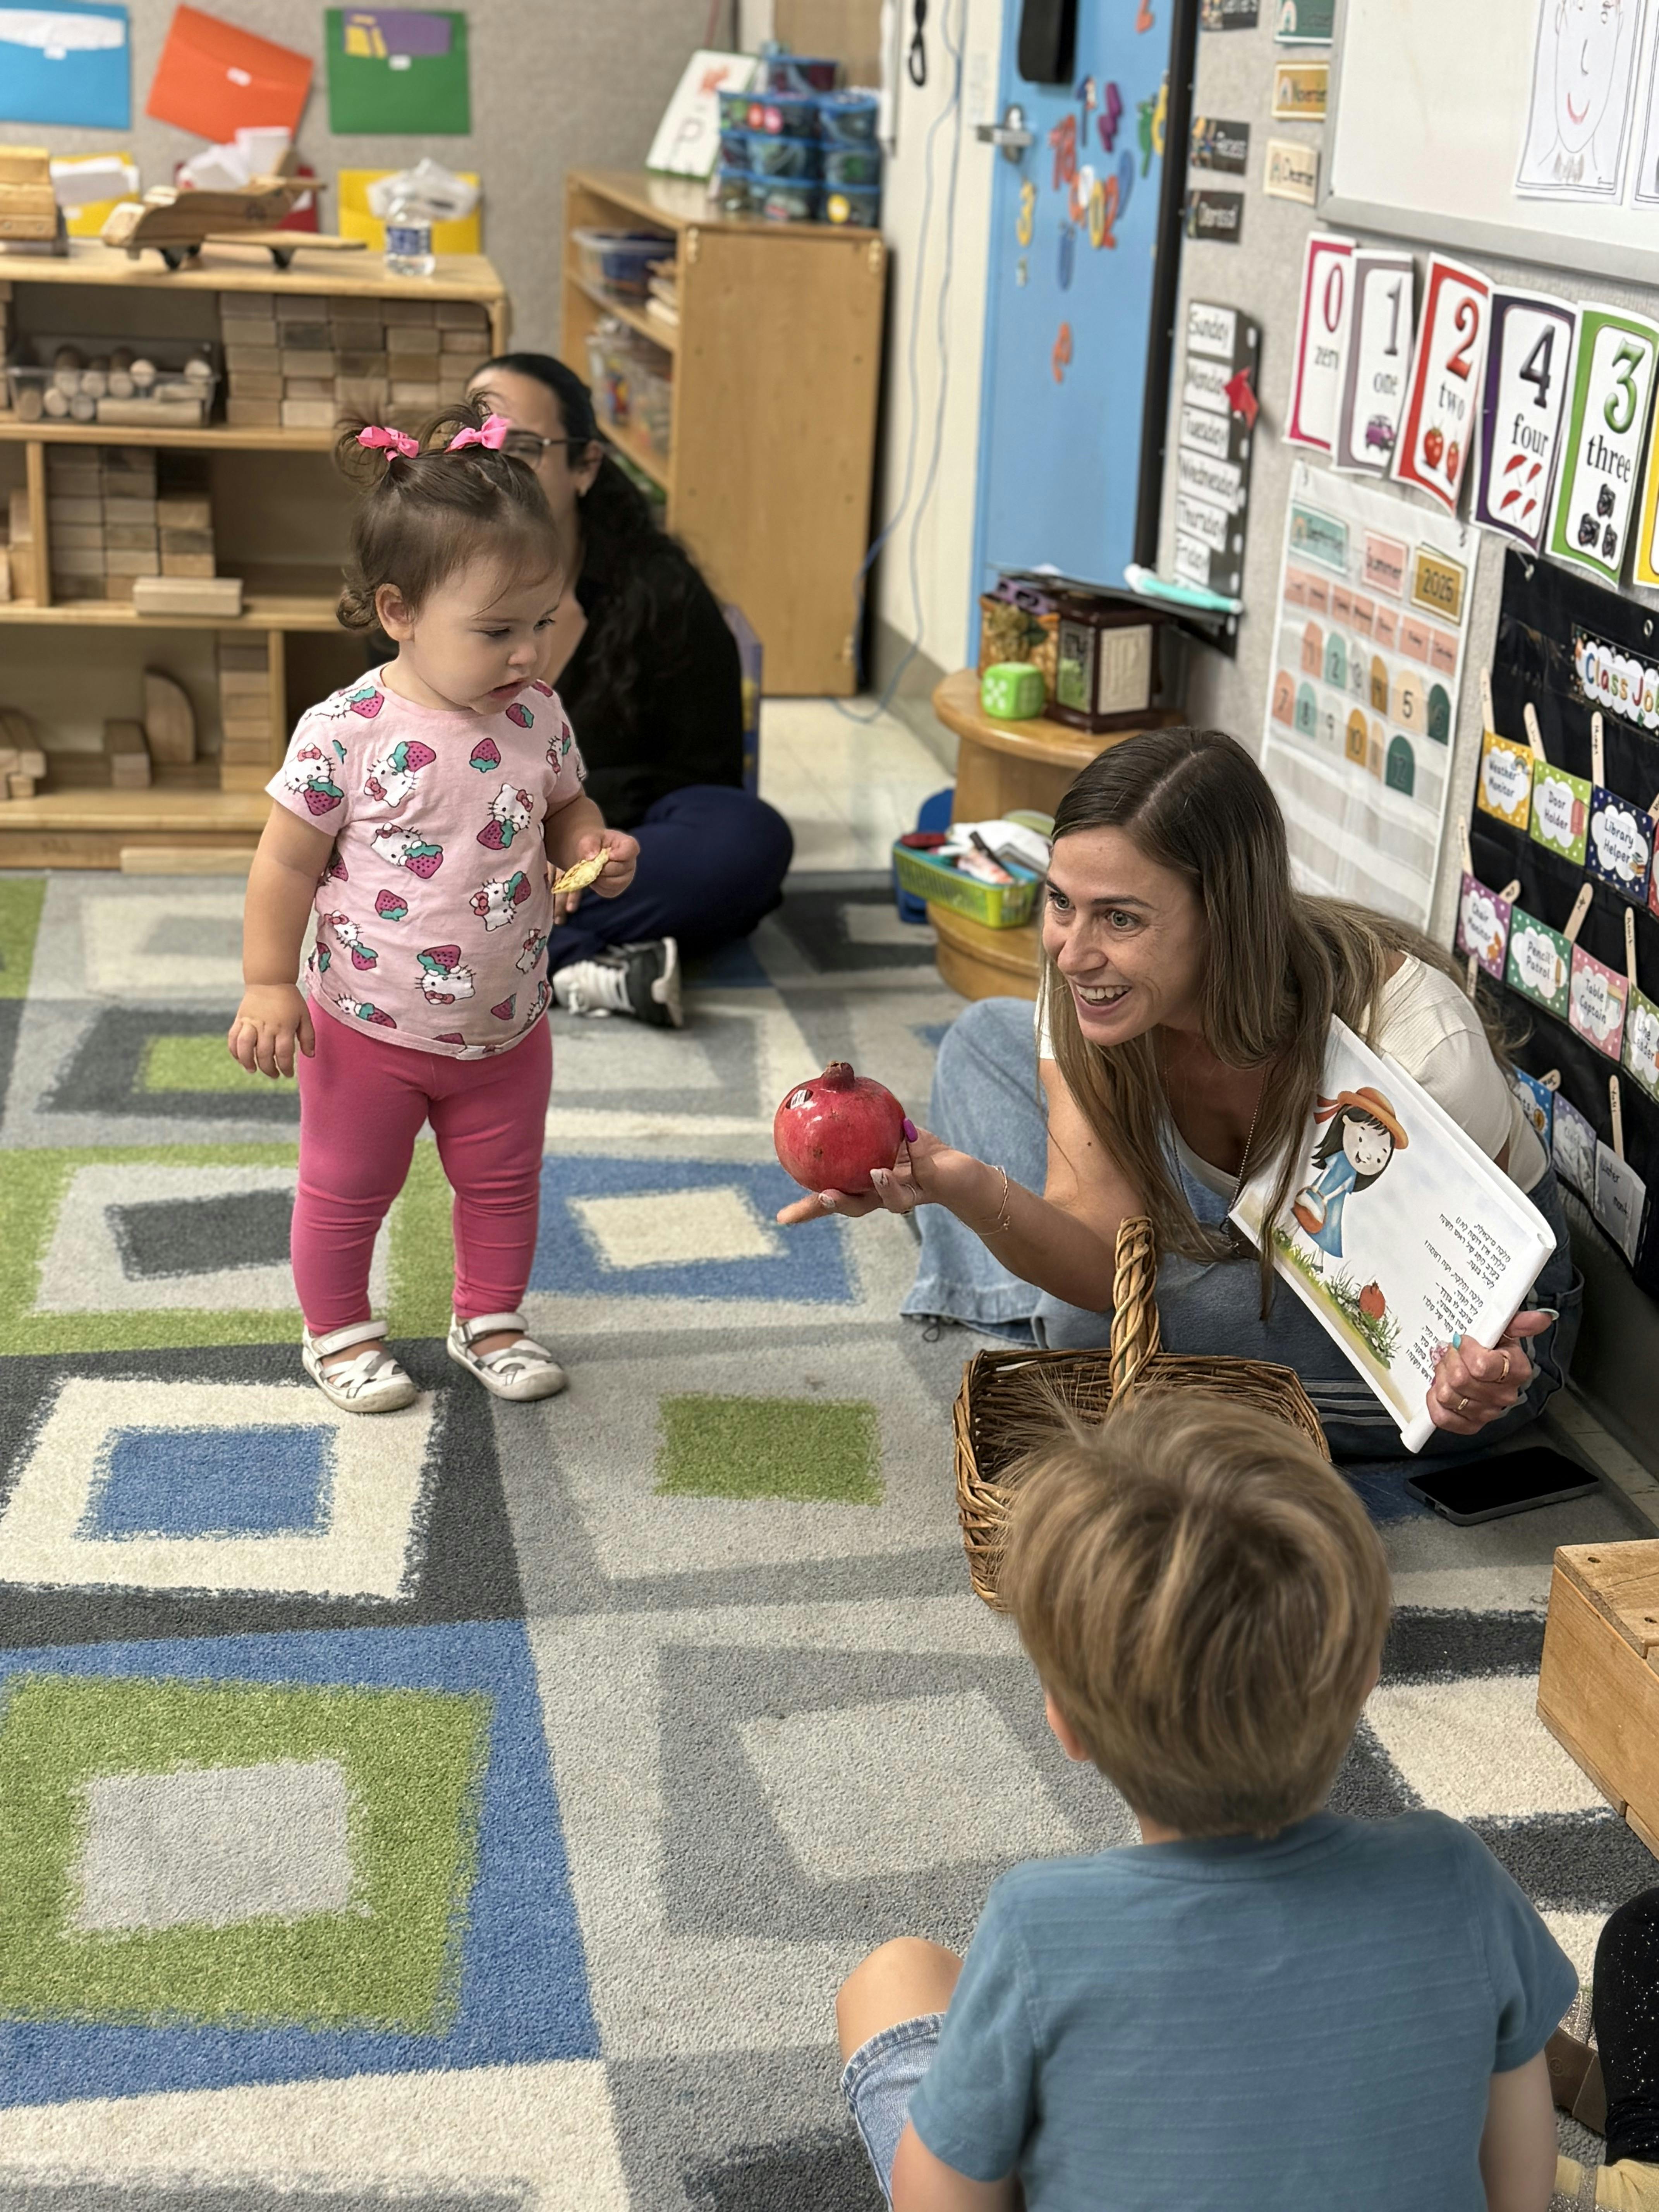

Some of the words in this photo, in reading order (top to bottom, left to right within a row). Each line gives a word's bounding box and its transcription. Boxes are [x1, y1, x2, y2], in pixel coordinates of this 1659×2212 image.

[1323, 263, 1343, 333] 0
[1189, 311, 1228, 349] Sunday
[1384, 277, 1402, 356] 1
[1446, 297, 1479, 381] 2
[1519, 323, 1556, 409] 4
[1373, 372, 1398, 396] one
[1604, 337, 1645, 434] 3
[1439, 383, 1465, 421] two
[1511, 412, 1549, 457] four
[1586, 434, 1632, 484] three
[1330, 651, 1340, 680] 2
[1583, 653, 1628, 700] Class
[1279, 688, 1289, 713] 7
[1301, 701, 1310, 727] 8
[1402, 690, 1414, 720] 5
[1326, 713, 1335, 740] 9
[1350, 728, 1361, 756] 10
[1488, 758, 1516, 780] Weather
[1488, 777, 1515, 799] Monitor
[1548, 790, 1566, 810] Door
[1544, 808, 1568, 831] Holder
[1604, 817, 1634, 849] Library
[1603, 838, 1630, 864] Helper
[1472, 903, 1489, 922] Chair
[1468, 916, 1491, 942] Monitor
[1528, 941, 1551, 965] Pencil
[1526, 955, 1551, 980] Patrol
[1586, 979, 1604, 1003] Table
[1580, 995, 1606, 1025] Captain
[1637, 1023, 1651, 1042] Line
